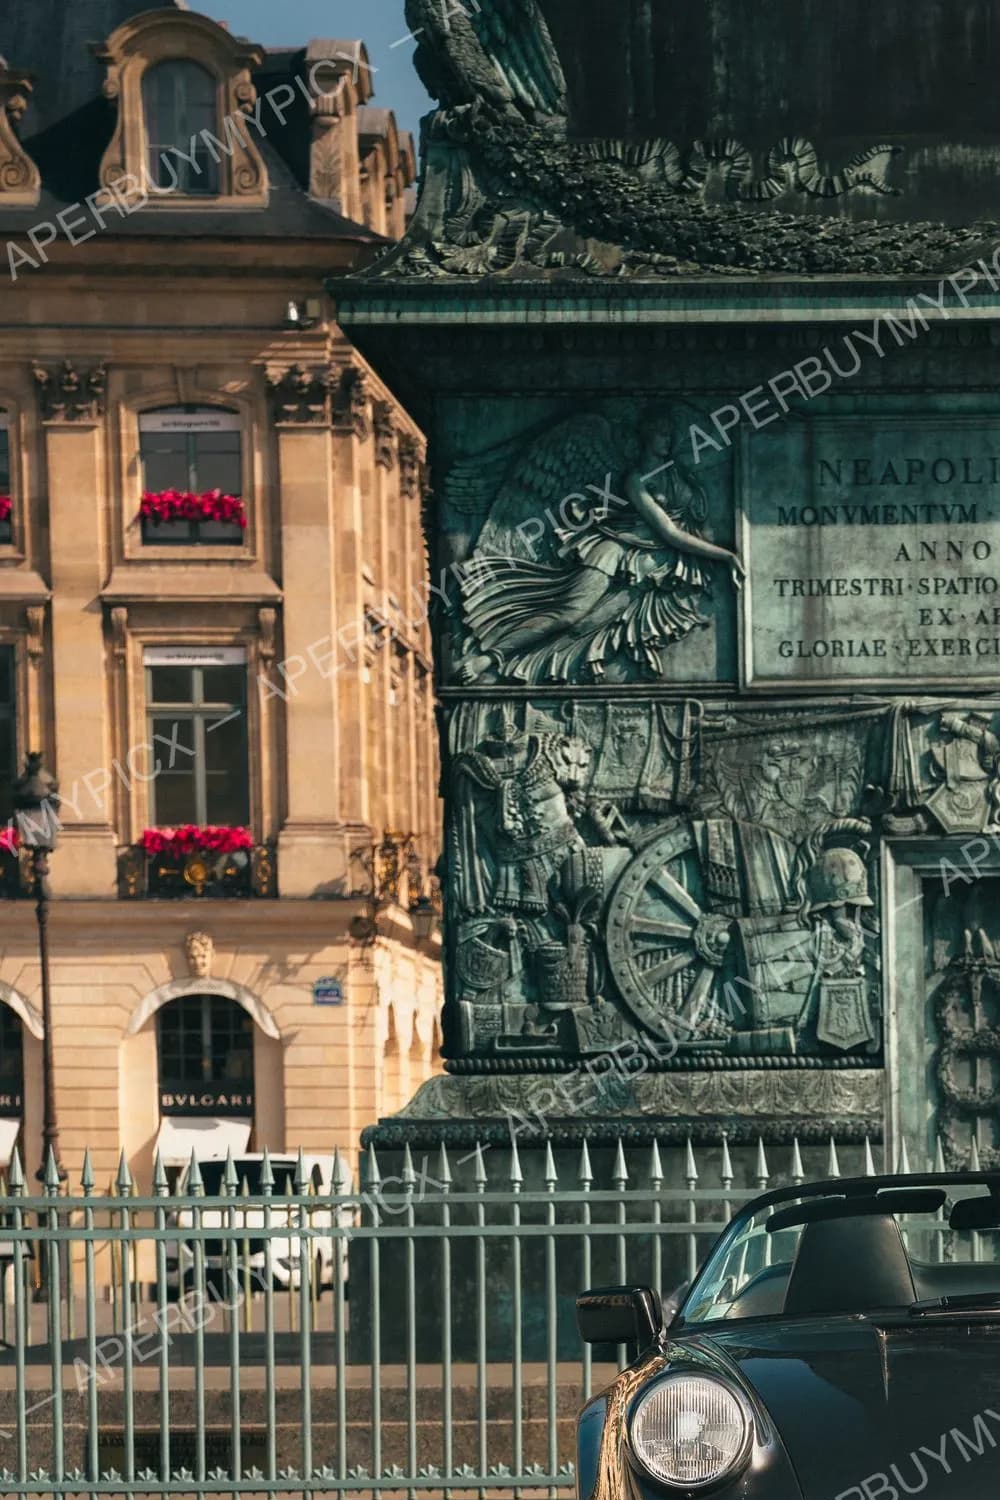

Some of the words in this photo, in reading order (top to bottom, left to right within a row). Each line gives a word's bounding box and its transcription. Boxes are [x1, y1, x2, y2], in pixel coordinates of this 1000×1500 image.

[777, 503, 978, 526] MONVMENTVM
[895, 541, 991, 561] ANNO
[774, 578, 904, 597] TRIMESTRI
[917, 577, 998, 595] SPATIO
[919, 608, 953, 626] EX
[778, 640, 887, 658] GLORIAE
[162, 1094, 252, 1107] BVLGARI
